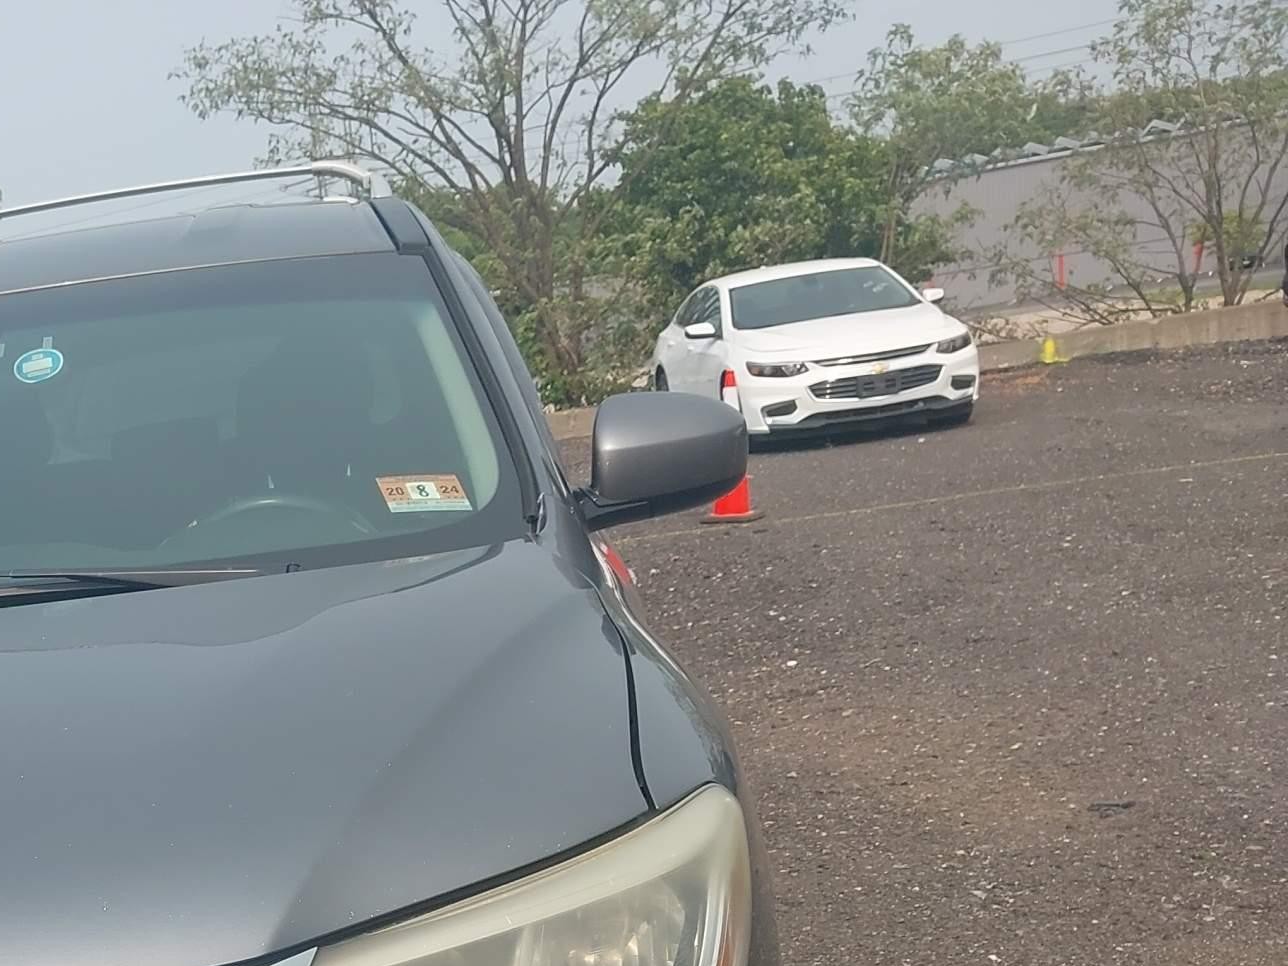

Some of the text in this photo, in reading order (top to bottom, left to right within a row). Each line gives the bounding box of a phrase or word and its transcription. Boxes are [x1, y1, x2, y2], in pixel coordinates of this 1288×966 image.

[385, 484, 460, 498] 20 8 24
